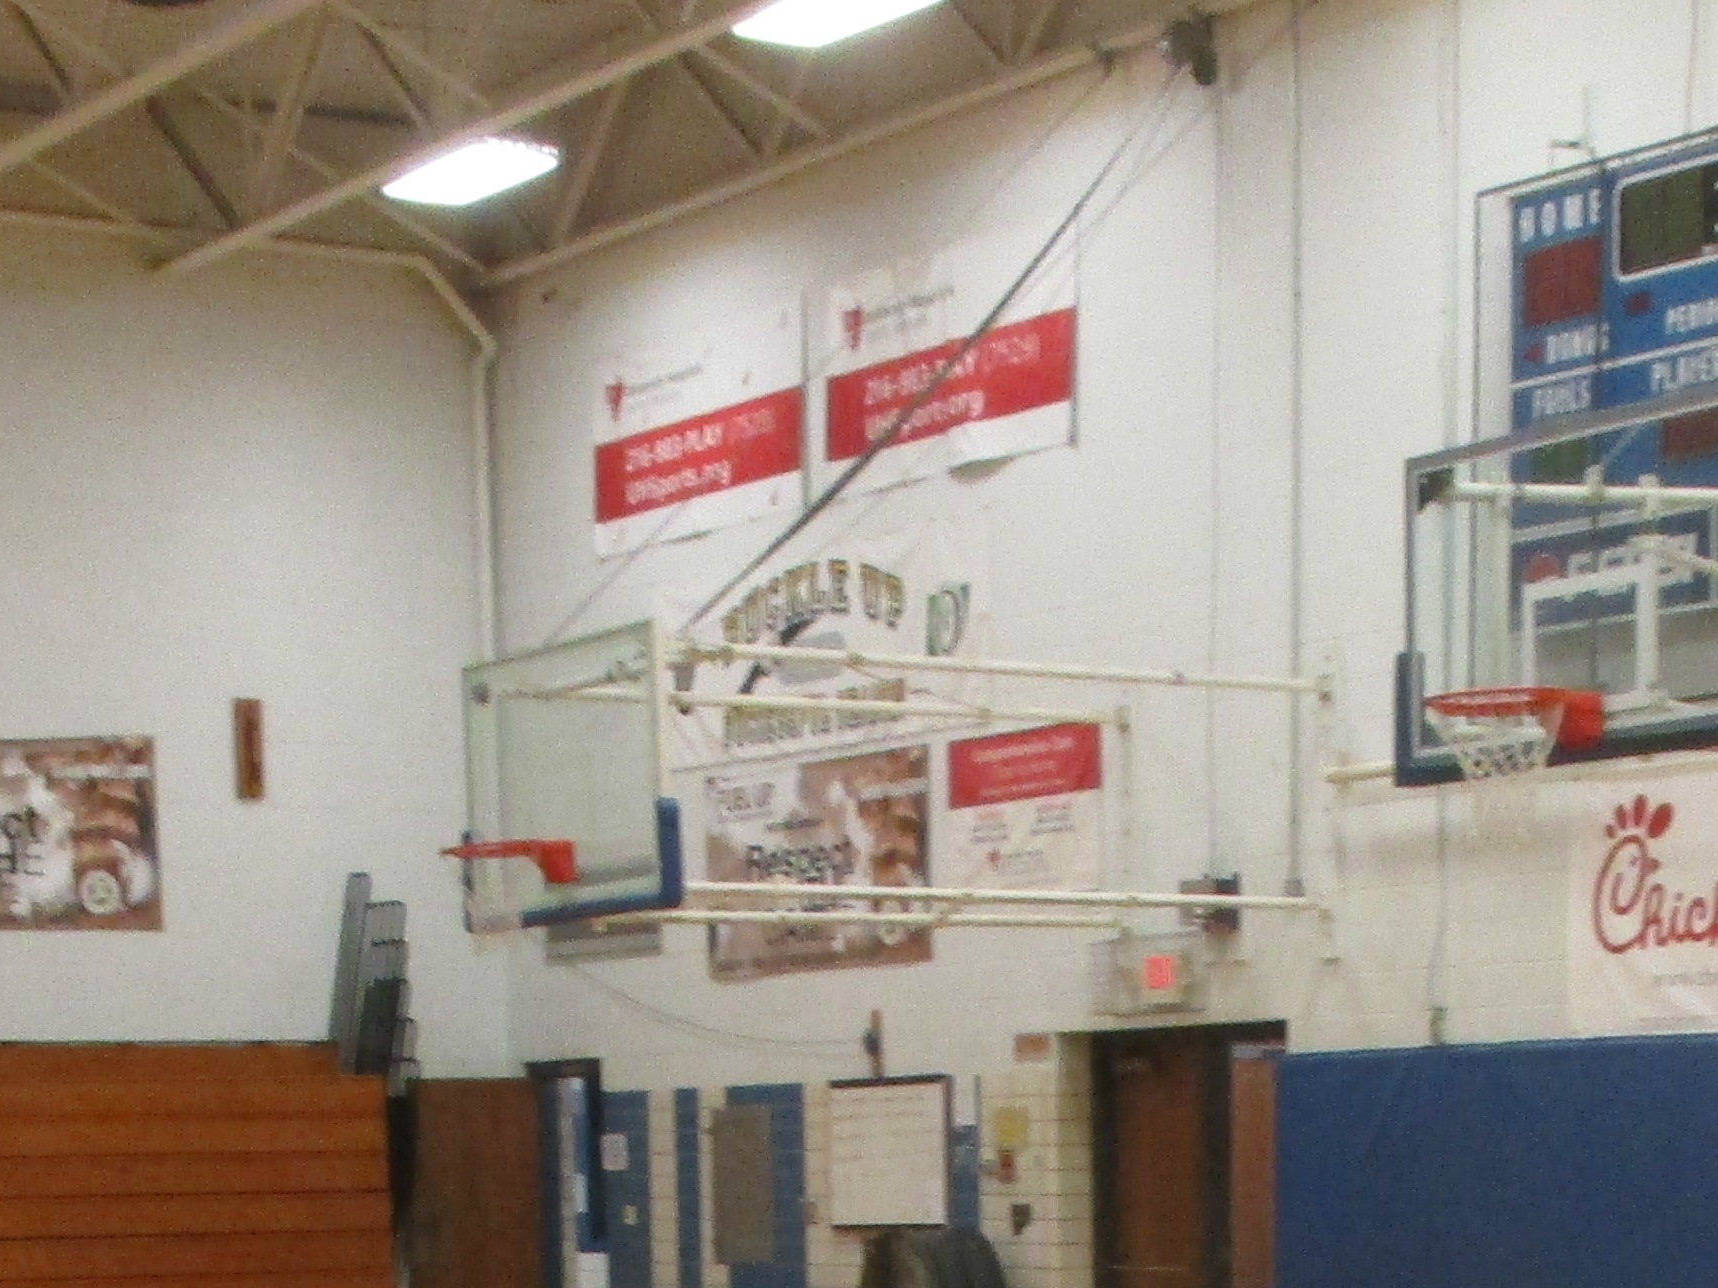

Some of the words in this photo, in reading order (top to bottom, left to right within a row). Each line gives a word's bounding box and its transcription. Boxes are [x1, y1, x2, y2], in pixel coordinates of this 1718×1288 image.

[1518, 187, 1604, 244] HOME
[1544, 321, 1611, 365] BONUS
[1531, 376, 1591, 419] FOULS
[858, 562, 905, 630] UP
